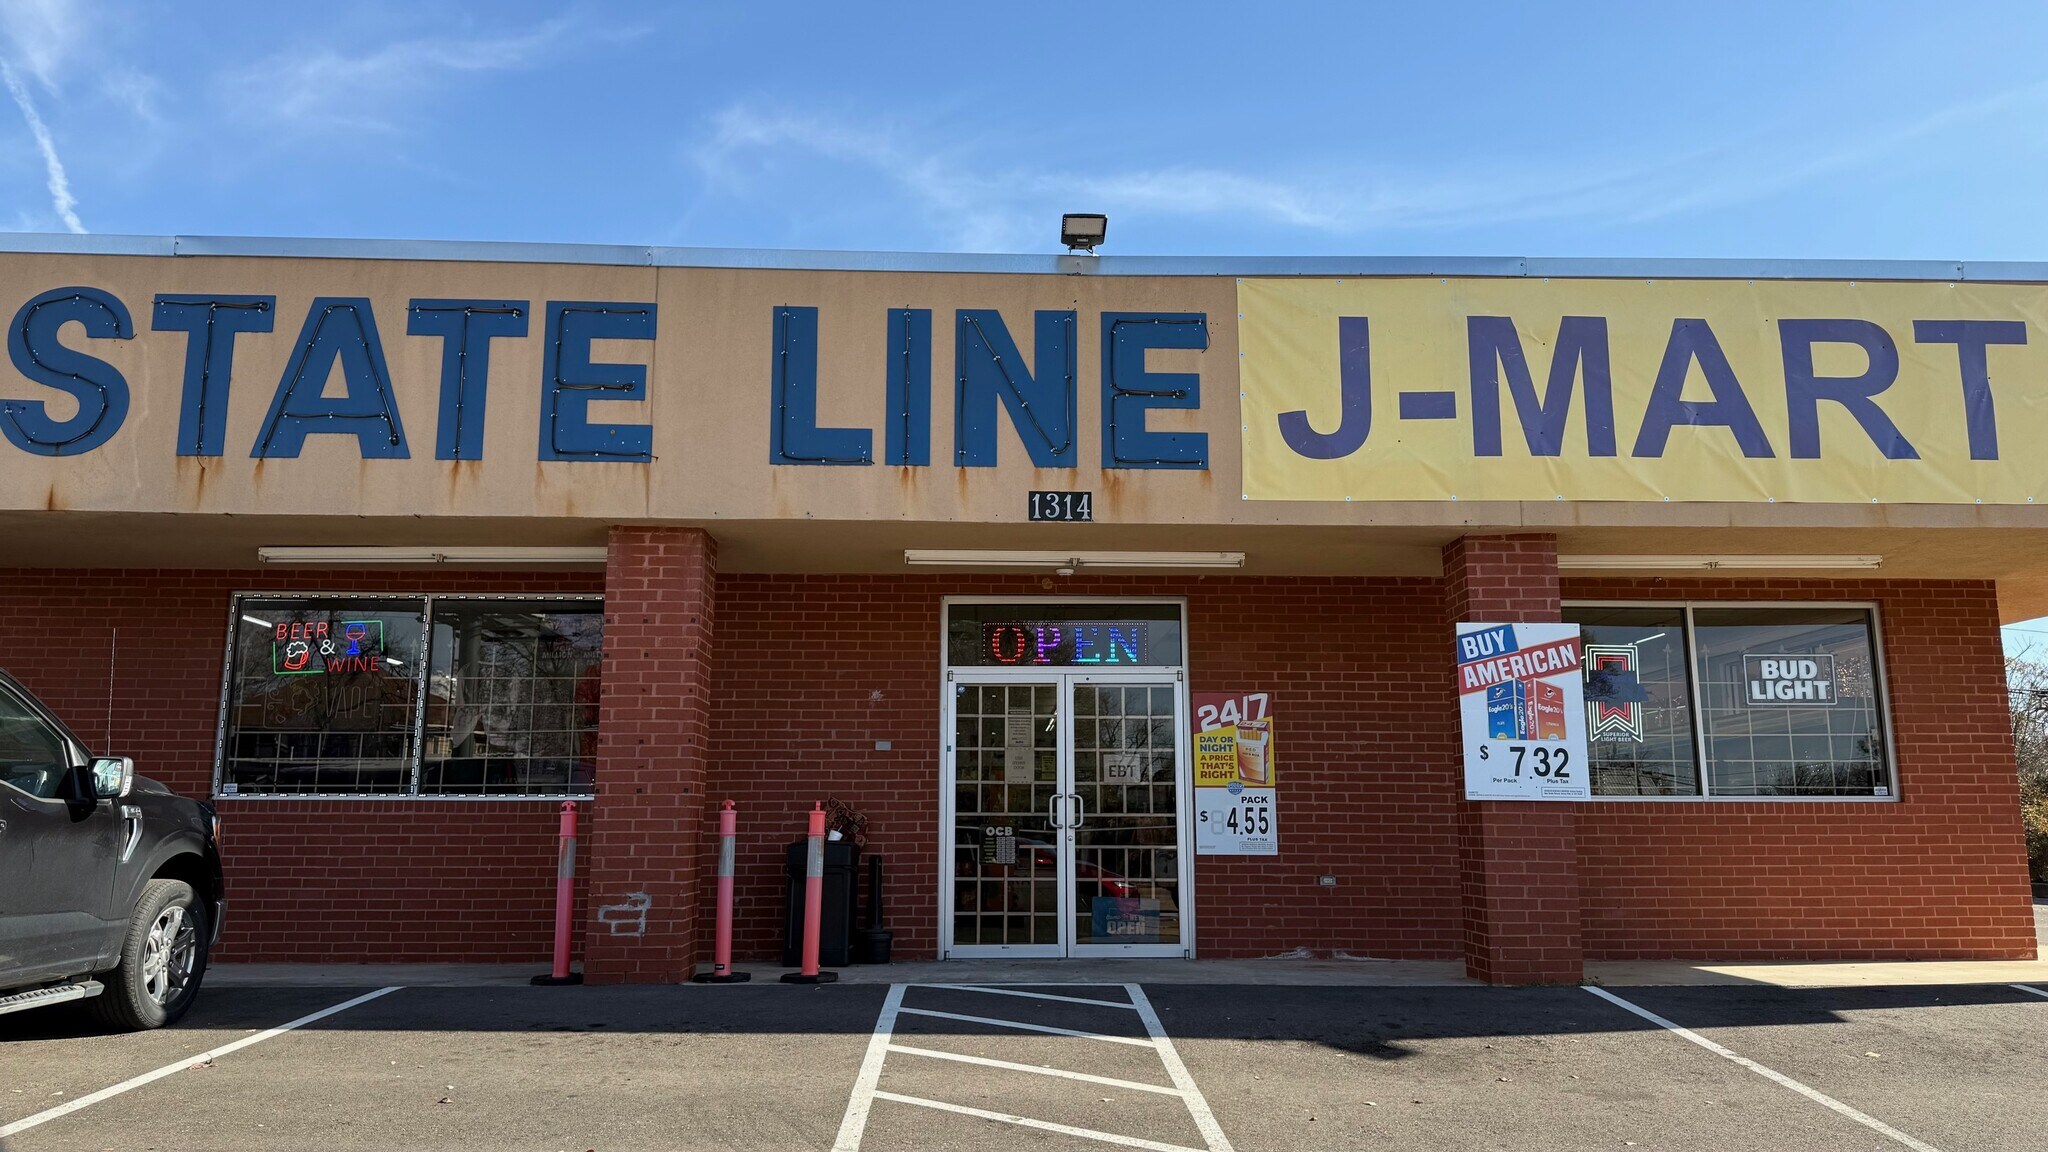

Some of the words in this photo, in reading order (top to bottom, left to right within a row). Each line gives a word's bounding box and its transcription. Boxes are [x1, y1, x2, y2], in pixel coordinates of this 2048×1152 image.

[0, 286, 657, 462] STATE
[770, 306, 1209, 469] LINE
[1278, 315, 2027, 460] J-MART
[1032, 493, 1091, 519] 1314
[276, 621, 328, 640] BEER
[319, 639, 336, 655] &
[992, 627, 1137, 662] OPEN
[1461, 629, 1506, 659] BUY
[326, 656, 380, 672] WINE
[1463, 643, 1577, 689] AMERICAN
[1760, 659, 1818, 680] BUD
[1751, 680, 1830, 700] LIGHT
[1197, 693, 1269, 733] 24/7
[1200, 744, 1234, 752] NIGHT
[1220, 736, 1234, 744] OR
[1109, 765, 1136, 777] EBT
[1480, 744, 1489, 761] $
[1509, 746, 1570, 780] 7.32
[1200, 771, 1235, 779] RIGHT
[1241, 796, 1268, 804] PACK
[985, 826, 1013, 836] OCB
[1200, 810, 1208, 823] $
[1226, 807, 1269, 835] 4.55
[1106, 920, 1146, 935] OPEN
